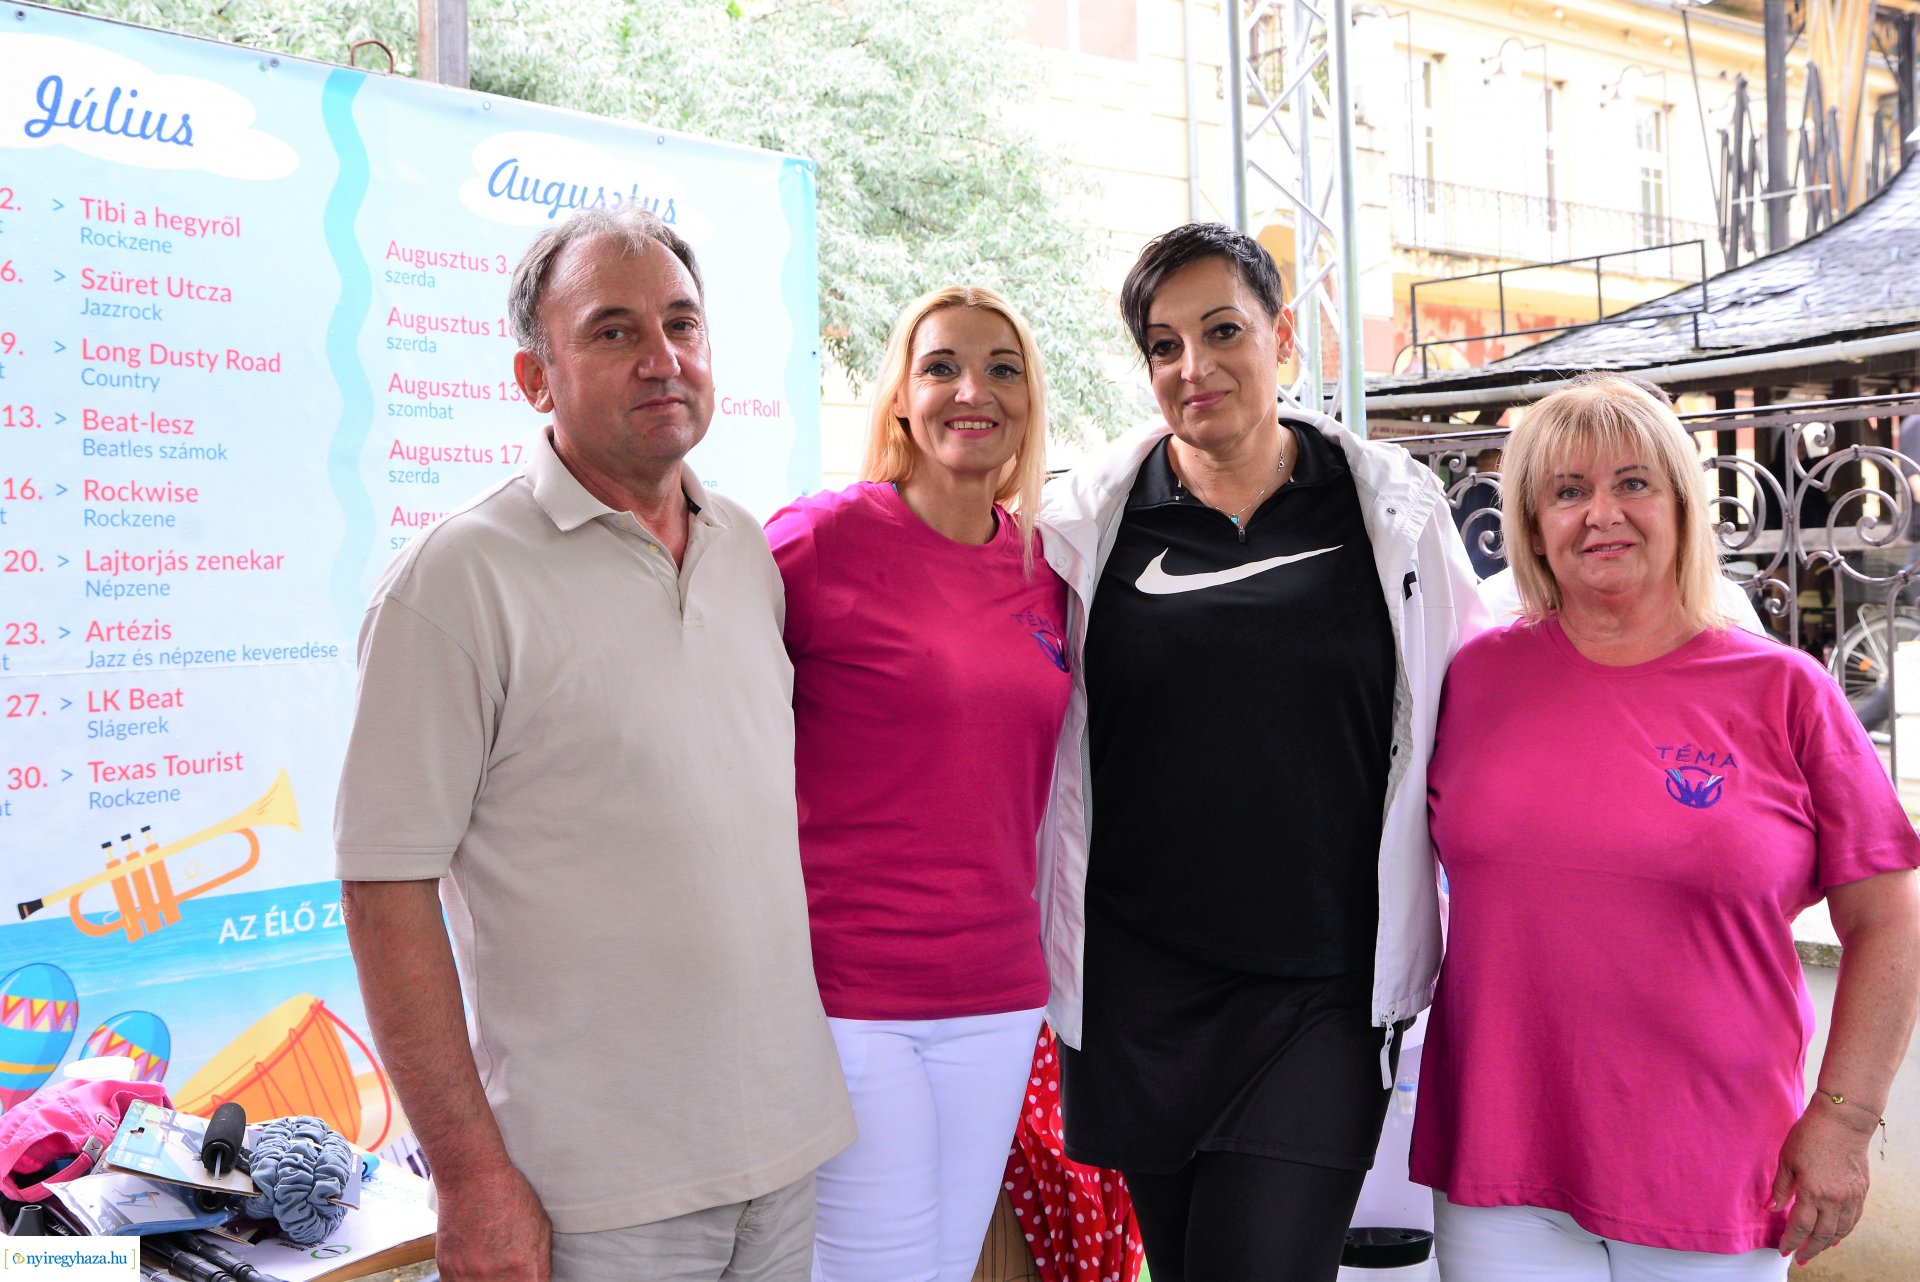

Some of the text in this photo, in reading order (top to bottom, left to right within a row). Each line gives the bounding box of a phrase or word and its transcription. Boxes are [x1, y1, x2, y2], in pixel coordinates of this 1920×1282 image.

[24, 75, 194, 147] Július
[79, 198, 241, 238] Tibi a hegyről
[80, 227, 172, 254] Rockzene
[386, 240, 512, 275] Augusztus 3.
[1, 260, 23, 283] 6.
[386, 270, 436, 288] szerda
[82, 268, 232, 302] Szüret Utcza
[80, 298, 162, 321] Jazzrock
[387, 306, 490, 336] Augusztus
[1, 332, 24, 355] 9.
[82, 338, 281, 373] Long Dusty Road
[386, 336, 436, 353] szerda
[81, 367, 160, 392] Country
[388, 372, 490, 400] Augusztus
[2, 404, 42, 428] 13.
[388, 403, 454, 420] szombat
[722, 397, 780, 418] Cnt'Roll
[83, 409, 194, 435] Beat-lesz
[82, 438, 228, 462] Beatles számok
[389, 440, 527, 466] Augusztus 17.
[388, 468, 440, 484] szerda
[4, 477, 43, 500] 16.
[84, 479, 198, 502] Rockwise
[84, 508, 176, 528] Rockzene
[4, 550, 44, 572] 20.
[86, 549, 284, 576] Lajtorjás zenekar
[86, 578, 170, 600] Népzene
[6, 622, 46, 646] 23.
[86, 618, 172, 642] Artézis
[86, 642, 338, 669] Jazz és népzene keveredése
[6, 694, 46, 718] 27.
[87, 687, 184, 712] LK Beat
[86, 716, 169, 740] Slágerek
[88, 751, 244, 783] Texas Tourist
[1656, 743, 1738, 769] TÉMA
[7, 766, 48, 790] 30.
[89, 786, 180, 810] Rockzene
[218, 915, 256, 944] AZ
[265, 900, 315, 937] ÉLŐ
